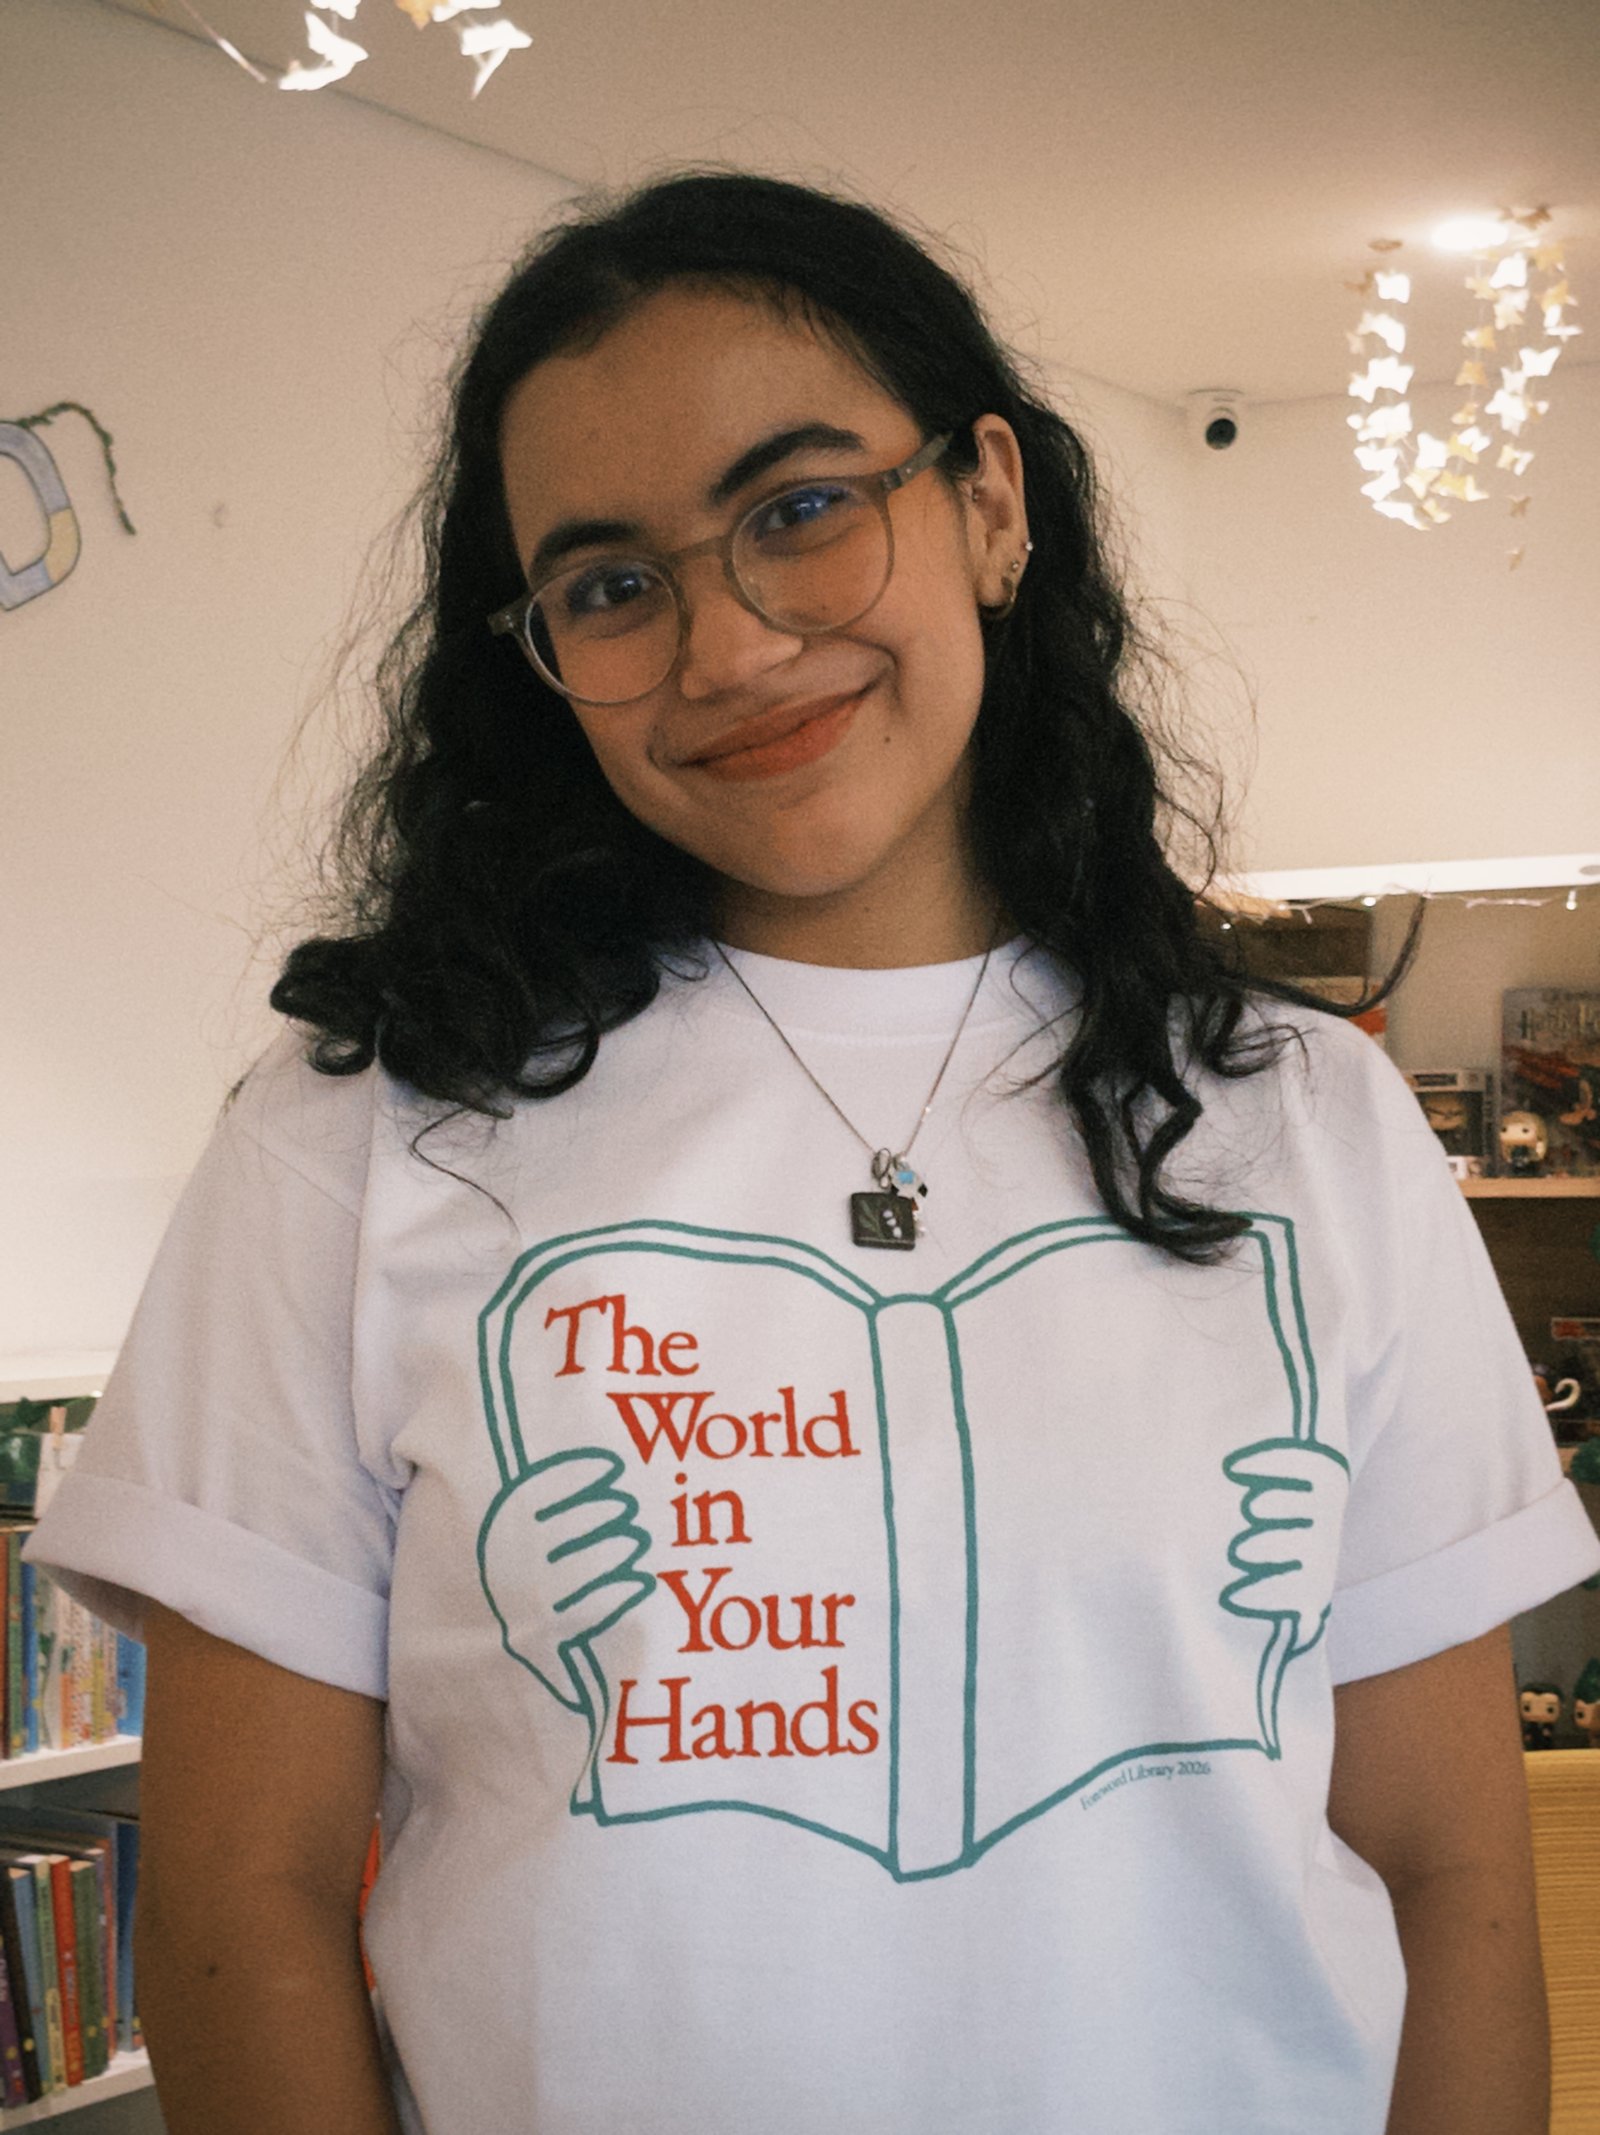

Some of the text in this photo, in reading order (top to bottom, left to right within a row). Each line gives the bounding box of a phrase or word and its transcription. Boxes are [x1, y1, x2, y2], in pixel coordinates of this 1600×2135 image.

[545, 1294, 700, 1377] The
[606, 1386, 860, 1463] World
[670, 1472, 752, 1546] in
[656, 1567, 855, 1652] Your
[605, 1666, 879, 1763] Hands
[1128, 1764, 1174, 1780] Library
[1177, 1761, 1212, 1776] 2026
